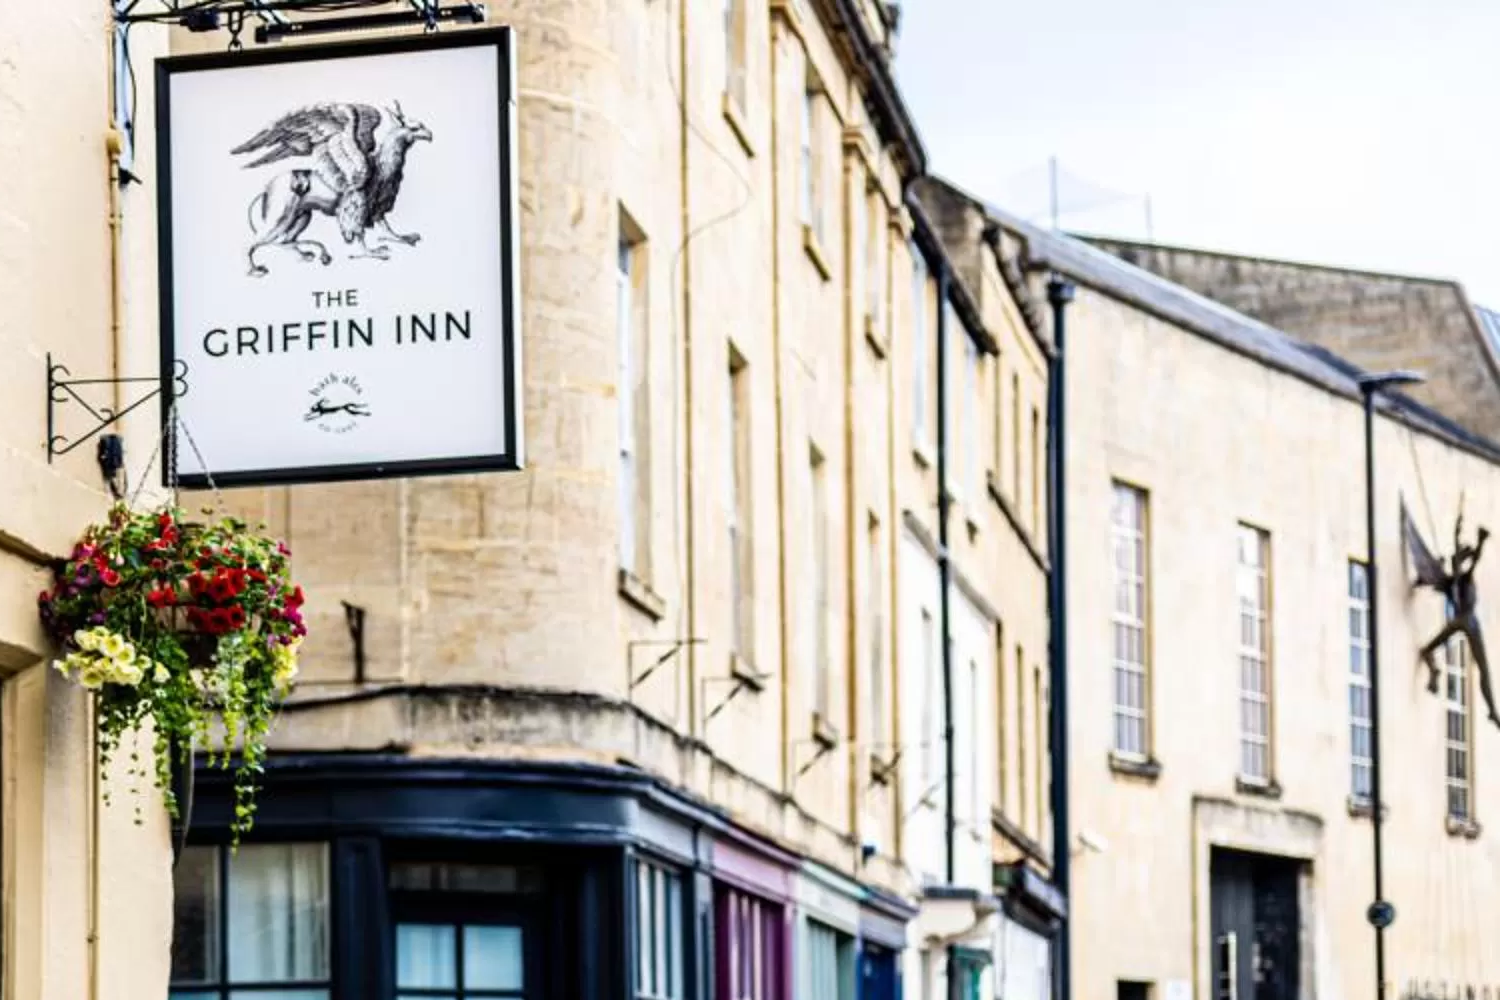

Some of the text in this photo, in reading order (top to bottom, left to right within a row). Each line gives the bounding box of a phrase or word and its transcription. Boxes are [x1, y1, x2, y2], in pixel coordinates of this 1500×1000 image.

[312, 289, 359, 308] THE
[203, 310, 471, 357] GRIFFIN INN
